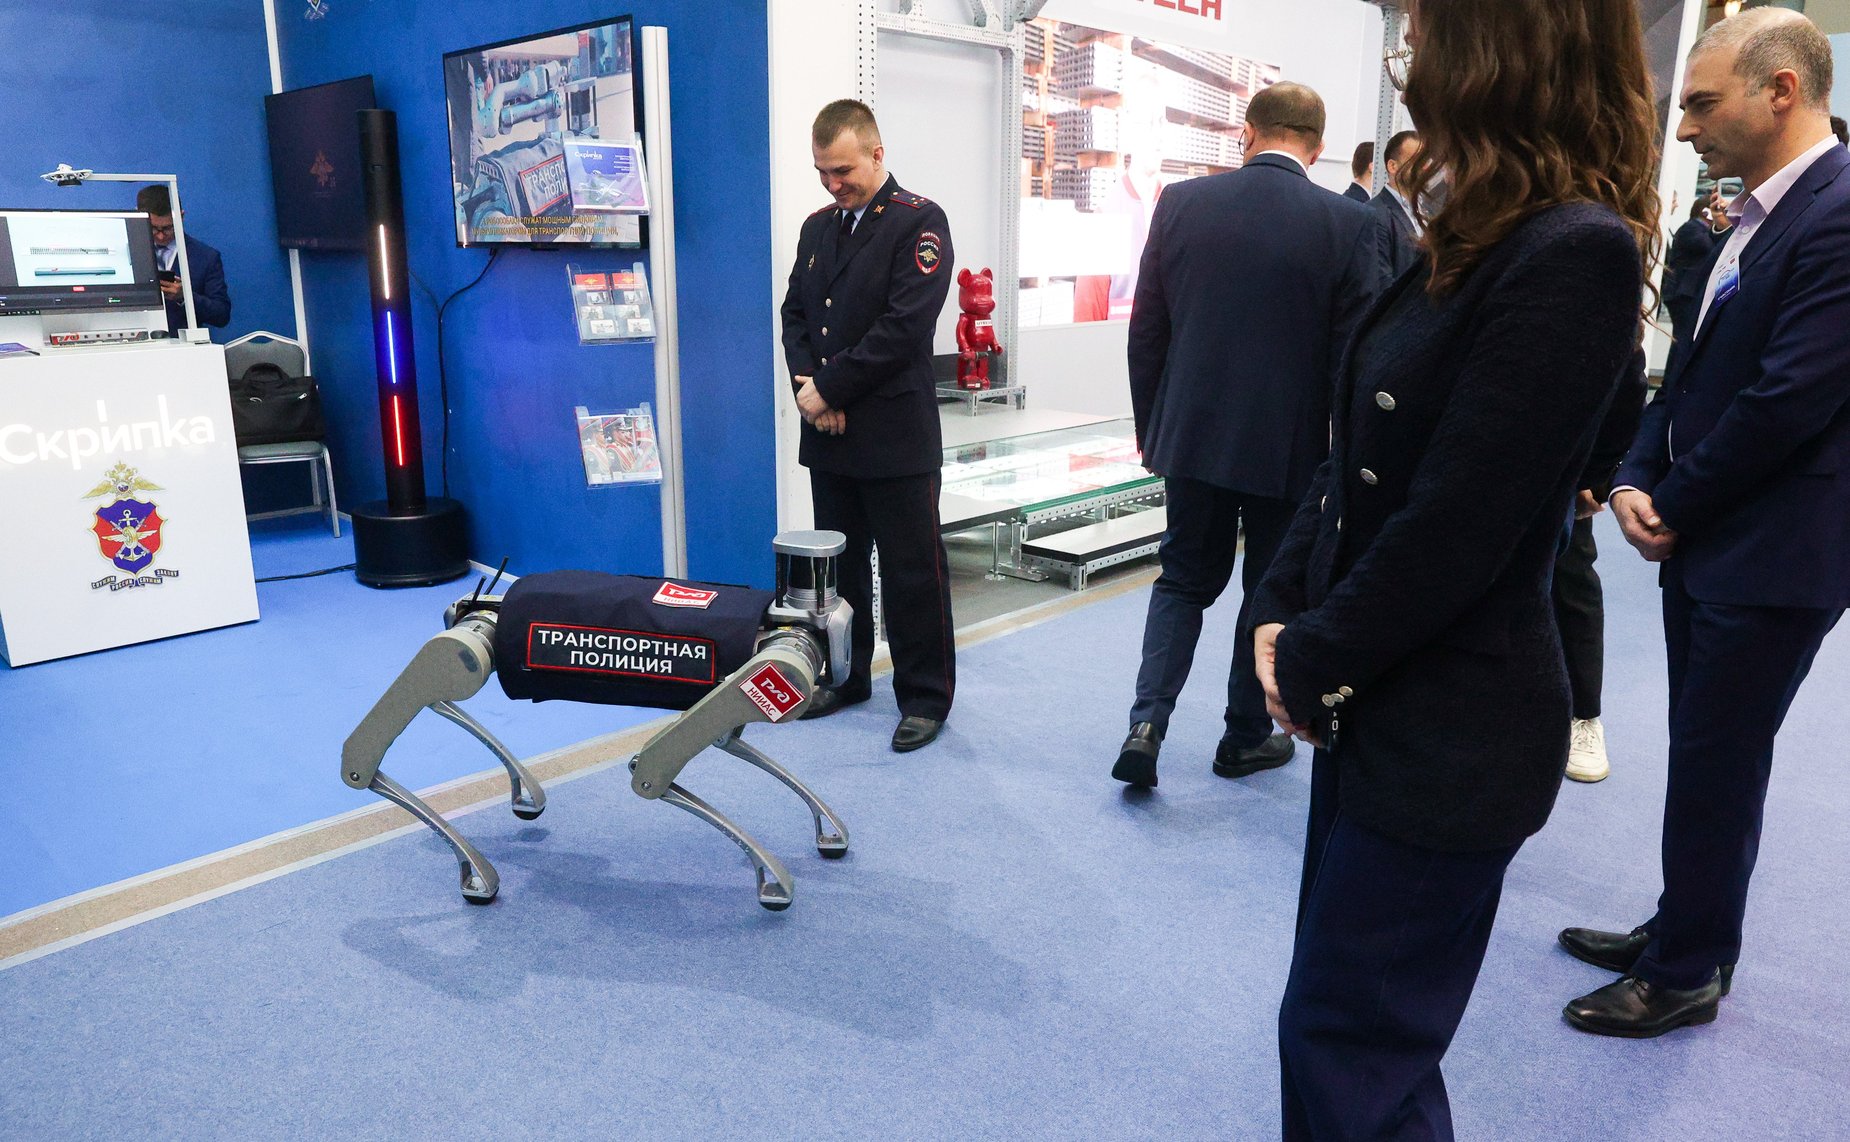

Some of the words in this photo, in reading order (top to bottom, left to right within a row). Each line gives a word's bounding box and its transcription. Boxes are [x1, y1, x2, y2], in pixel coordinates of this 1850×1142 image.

[0, 394, 216, 470] Скрипка
[538, 630, 706, 660] ТРАНСПОРТНАЯ
[570, 650, 672, 674] ПОЛИЦИЯ
[747, 687, 777, 716] НИИАС
